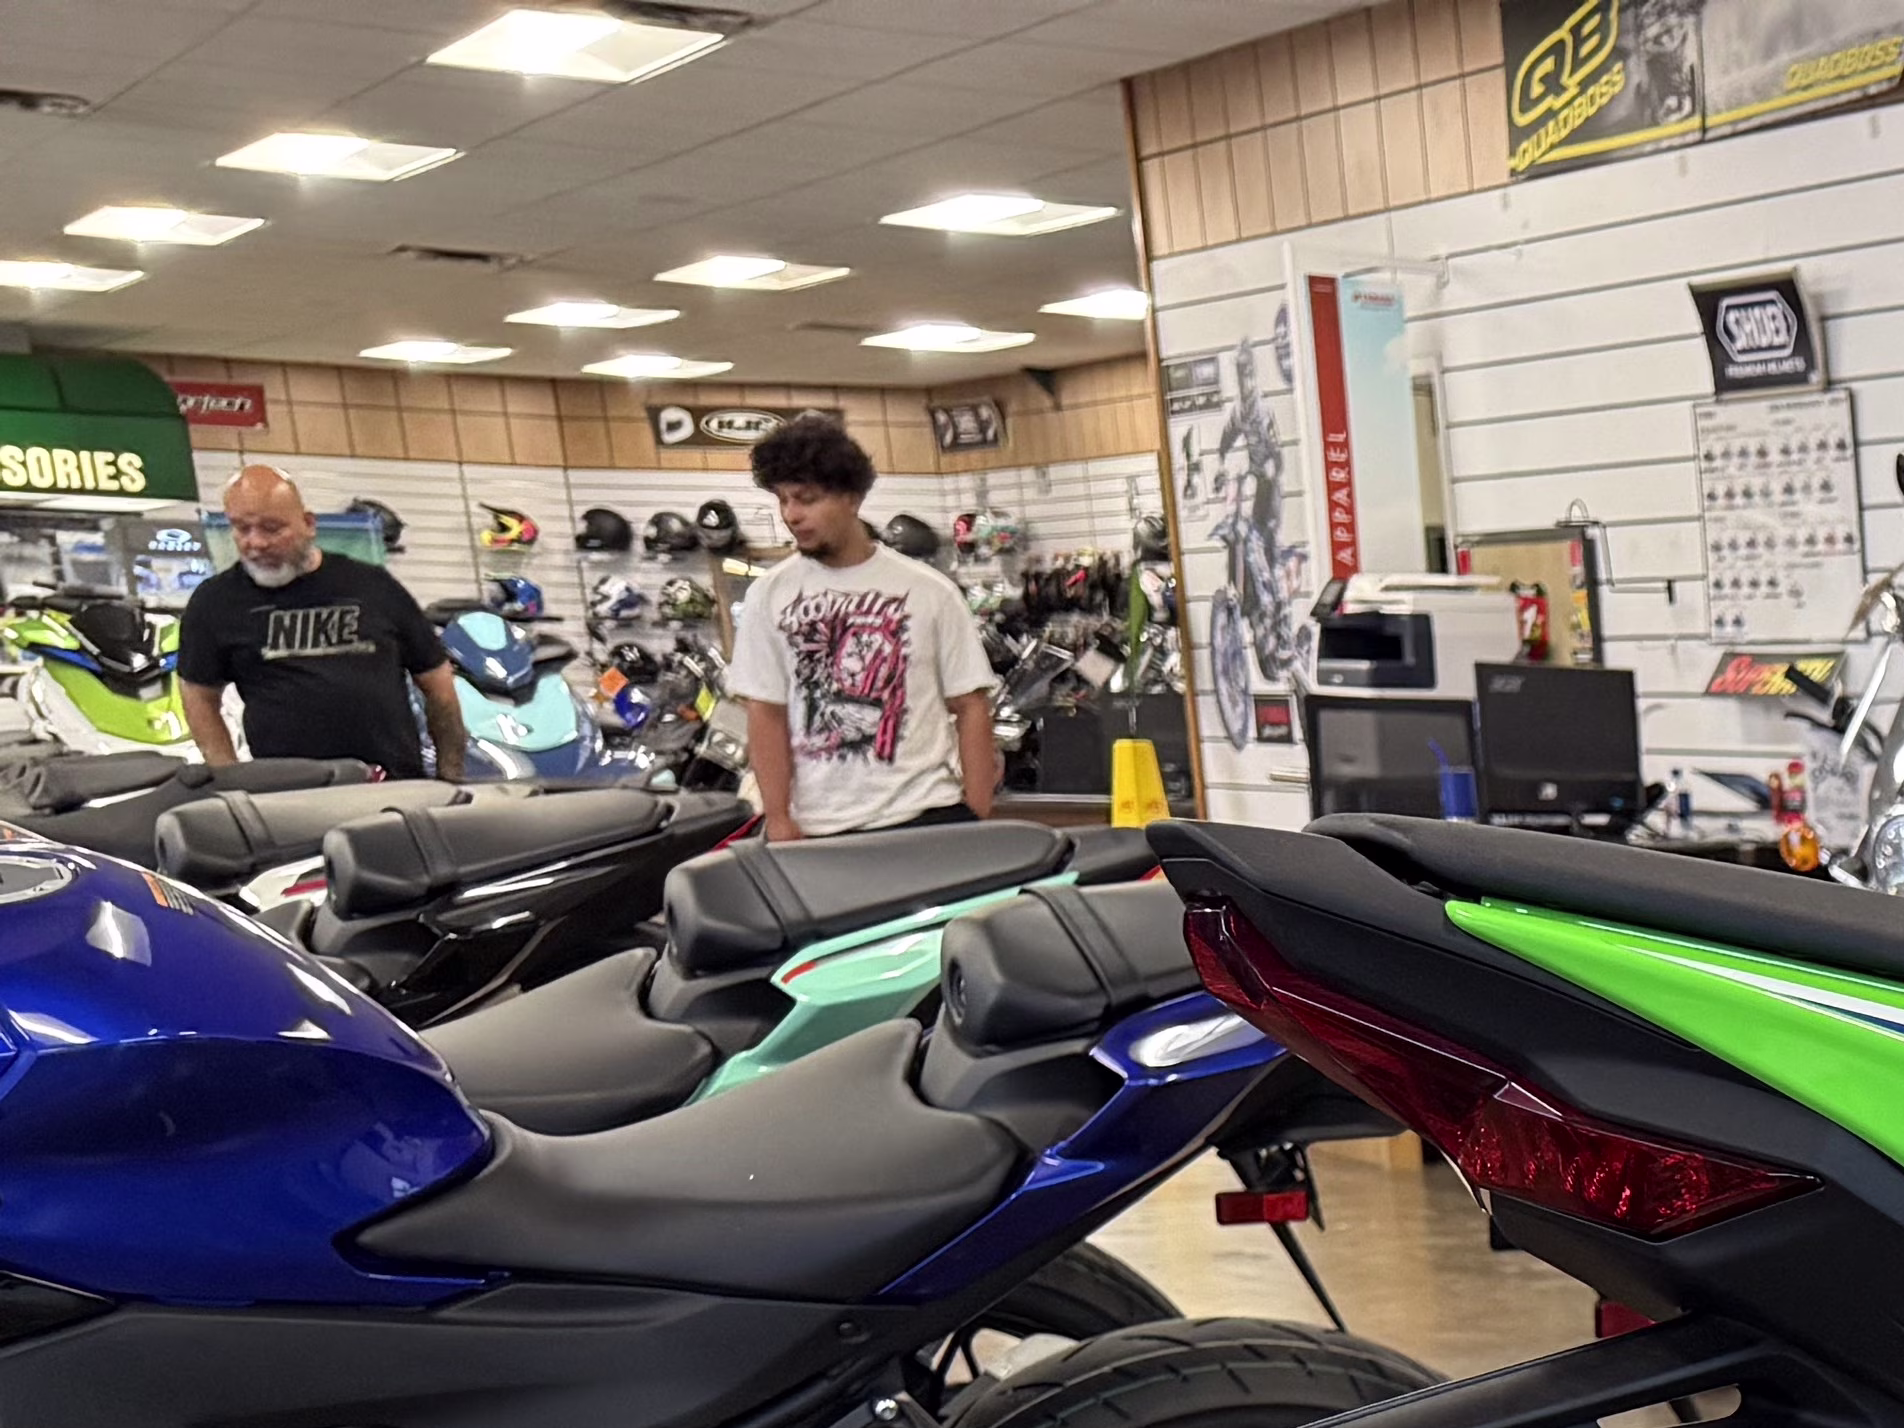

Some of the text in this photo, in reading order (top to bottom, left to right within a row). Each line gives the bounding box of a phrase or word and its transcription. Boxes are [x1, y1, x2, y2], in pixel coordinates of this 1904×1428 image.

[1786, 35, 1903, 90] QUADBOSS
[1514, 61, 1625, 172] QUADBOSS
[1325, 430, 1356, 566] APPAREL
[268, 604, 361, 652] NIKE
